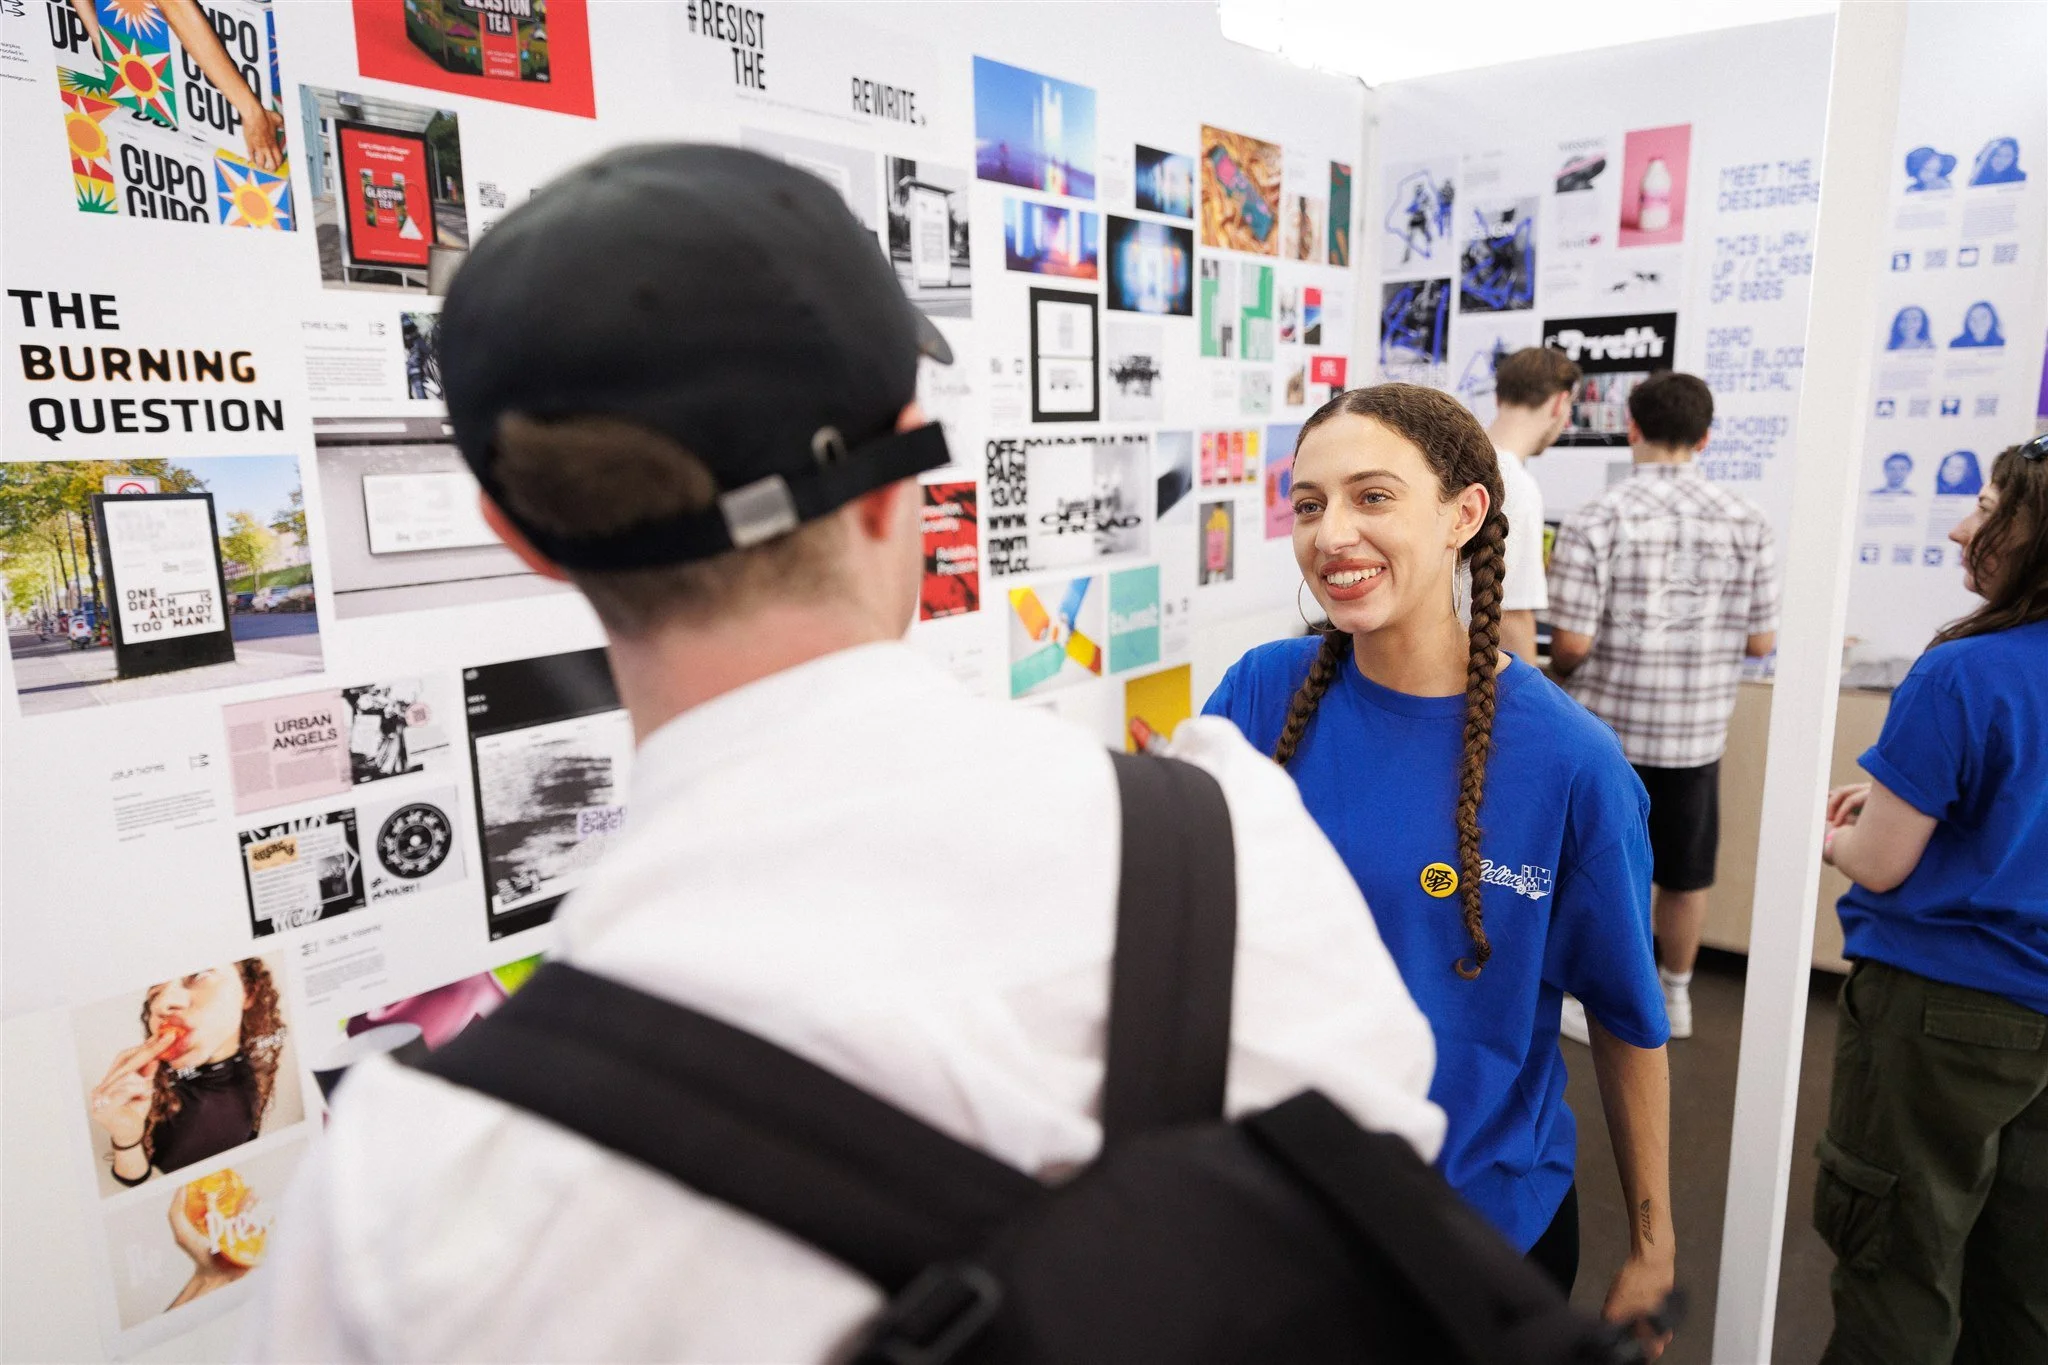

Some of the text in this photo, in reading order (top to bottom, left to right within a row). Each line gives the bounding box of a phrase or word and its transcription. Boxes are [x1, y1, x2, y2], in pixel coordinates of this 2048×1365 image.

[486, 12, 511, 34] TEA
[687, 0, 765, 50] #RESIST
[731, 47, 766, 90] THE
[185, 81, 243, 135] CUP
[120, 143, 207, 205] CUPO
[1720, 158, 1811, 189] MEET THE
[7, 288, 120, 330] THE
[19, 344, 257, 383] BURNING
[28, 397, 285, 441] QUESTION
[127, 588, 156, 600] ONE
[129, 598, 176, 612] DEATH
[133, 621, 162, 634] TOO
[149, 604, 213, 620] ALREADY
[272, 728, 338, 750] ANGELS
[274, 714, 332, 735] URBAN
